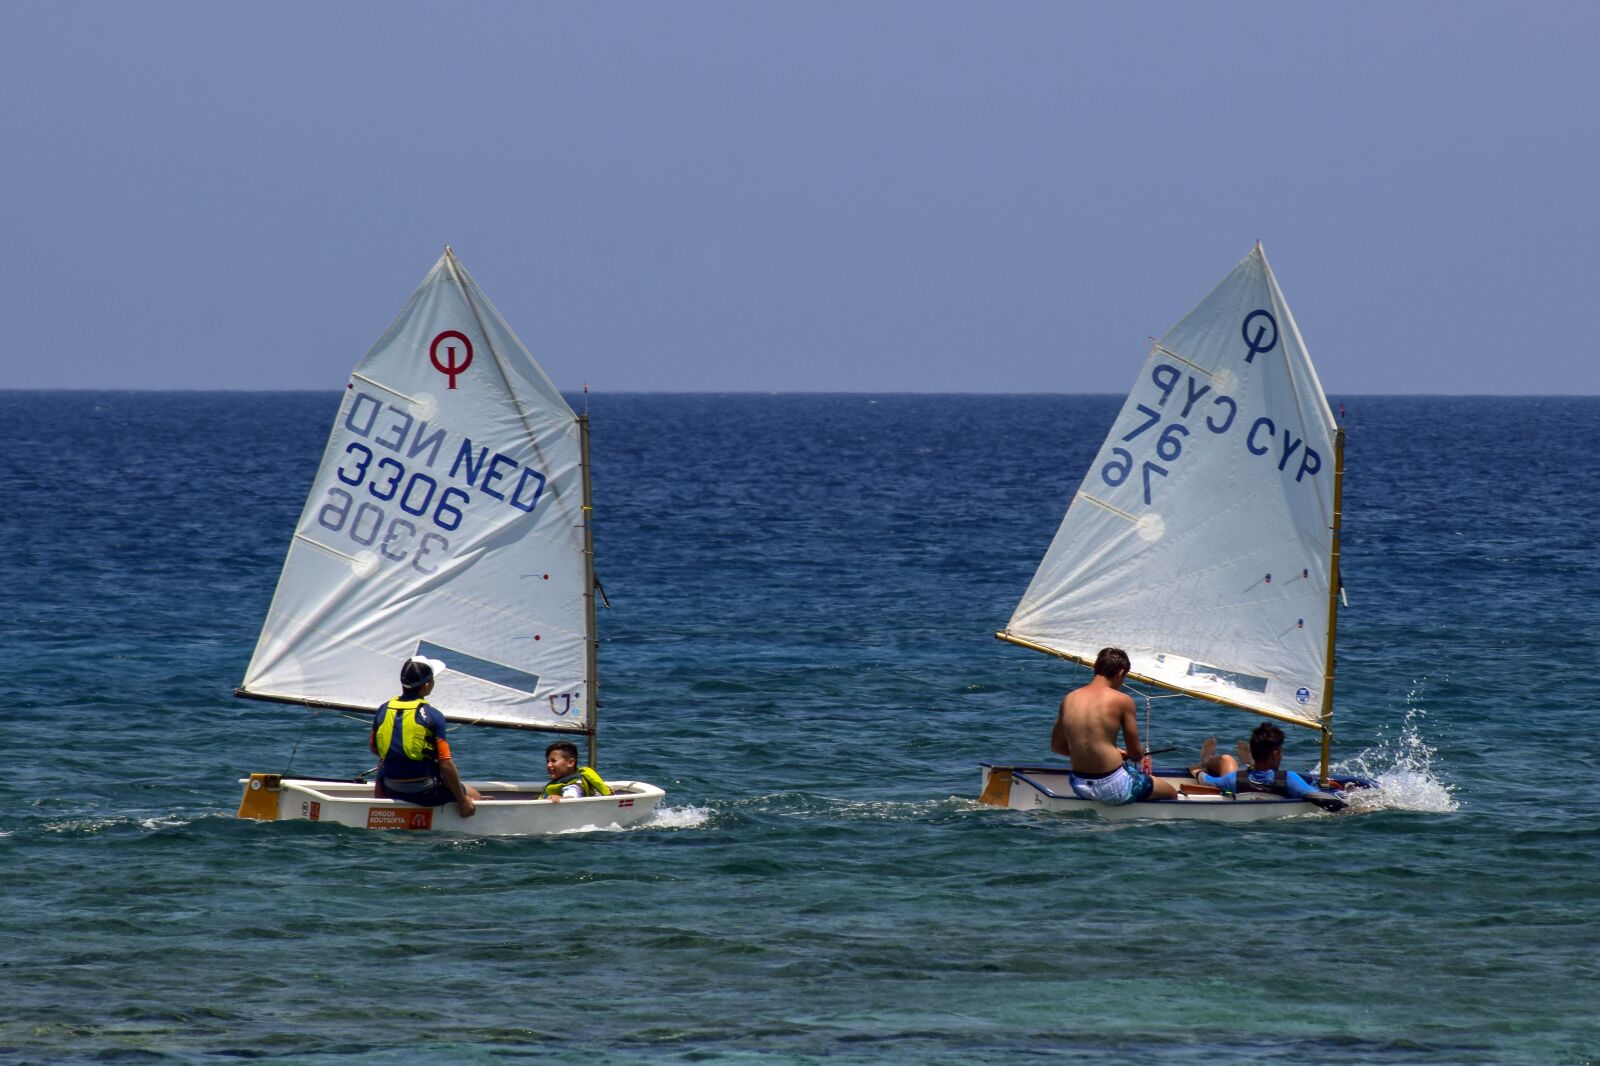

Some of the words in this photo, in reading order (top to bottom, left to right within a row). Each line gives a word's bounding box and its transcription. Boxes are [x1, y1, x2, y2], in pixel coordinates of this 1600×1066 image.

[1122, 403, 1191, 462] 76
[1246, 417, 1322, 483] CYP
[337, 442, 471, 531] 3306
[448, 437, 547, 513] NED
